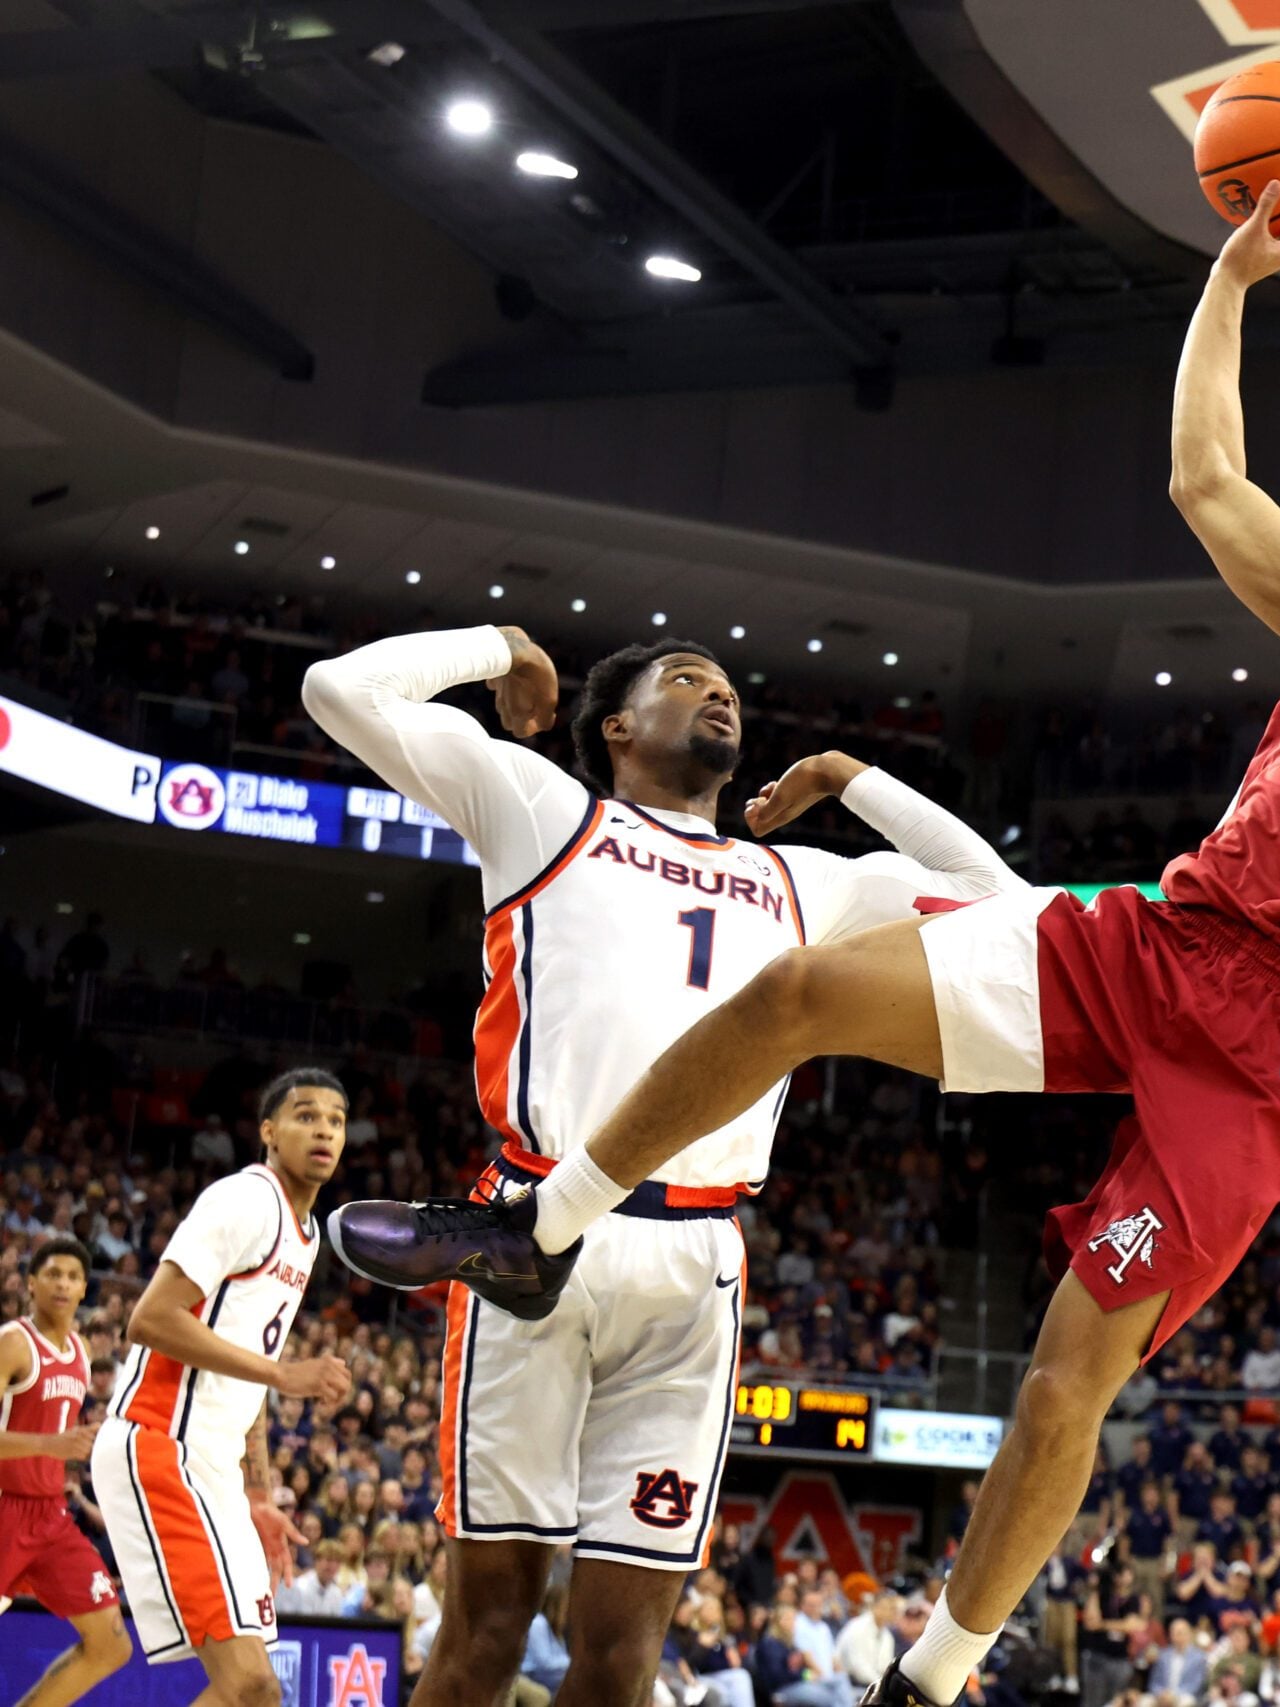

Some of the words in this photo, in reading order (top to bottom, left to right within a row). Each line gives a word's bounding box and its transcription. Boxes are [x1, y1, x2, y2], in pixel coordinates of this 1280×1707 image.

[258, 776, 309, 812] Blake
[587, 835, 783, 923] AUBURN
[677, 906, 716, 992] 1
[263, 1300, 288, 1355] 6
[58, 1399, 71, 1434] 1
